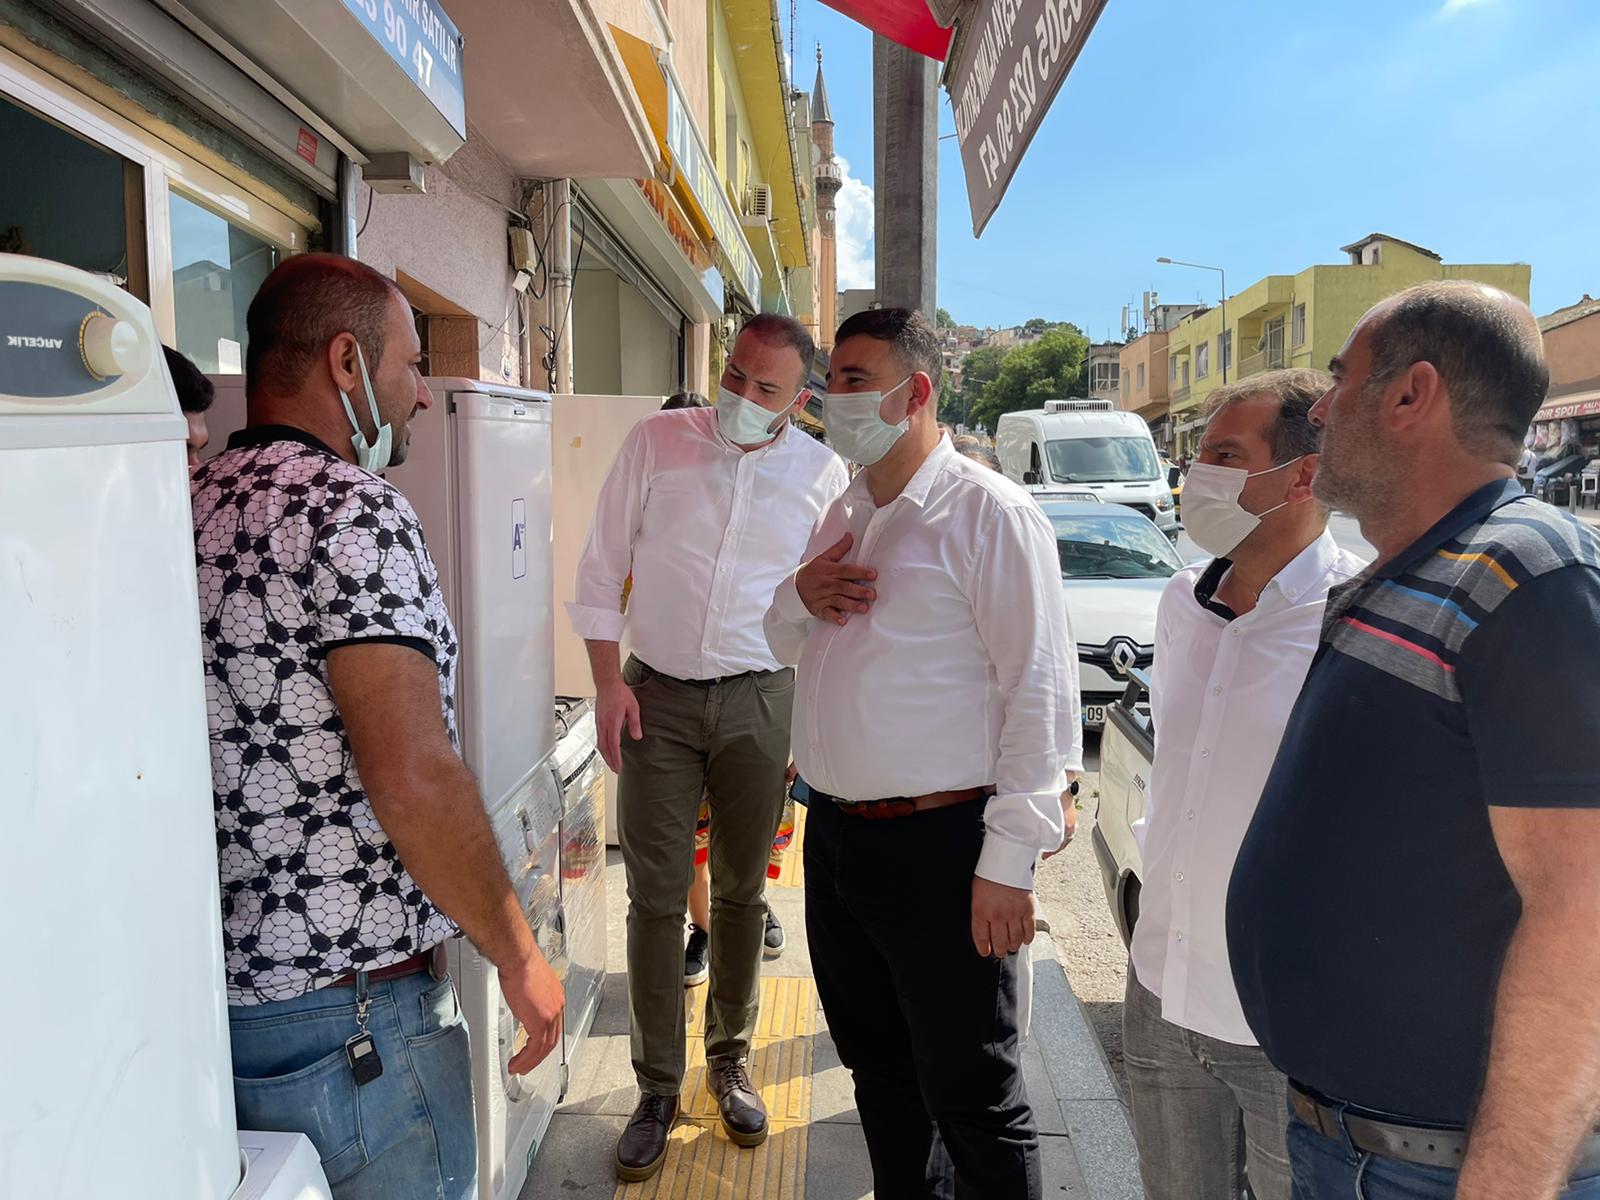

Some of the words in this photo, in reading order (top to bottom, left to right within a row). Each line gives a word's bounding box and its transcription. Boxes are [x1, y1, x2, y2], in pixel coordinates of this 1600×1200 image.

[383, 0, 407, 58] 90
[412, 39, 433, 88] 47
[421, 0, 457, 75] SATILIR
[667, 207, 696, 265] SPOT
[6, 335, 63, 349] ARÇELİK
[1554, 404, 1581, 418] SPOT
[1087, 706, 1103, 721] 09
